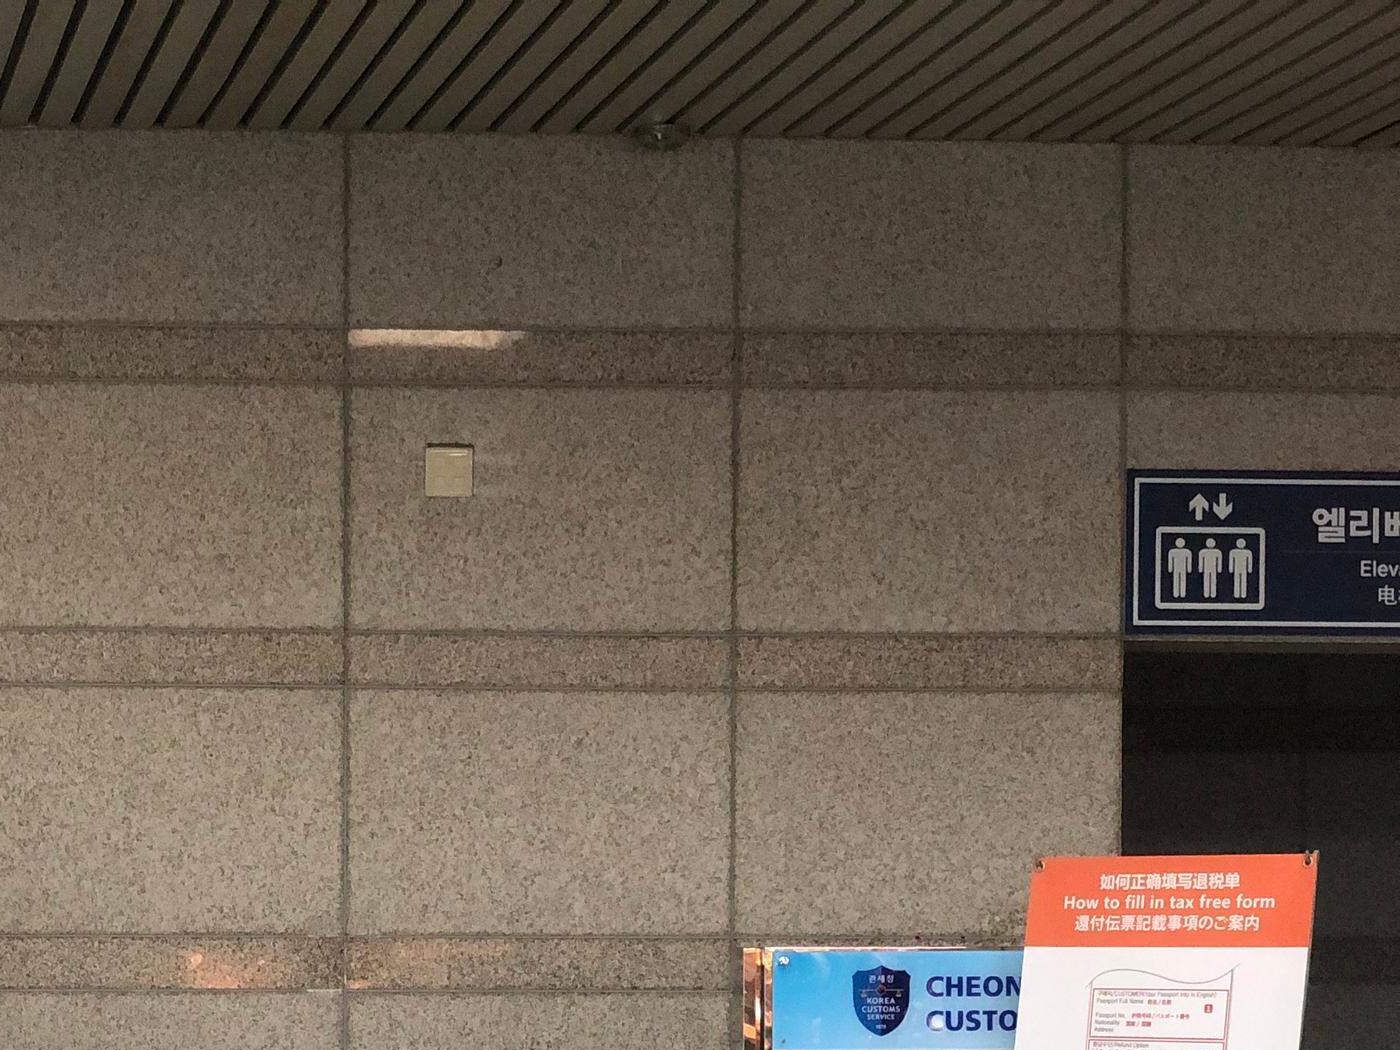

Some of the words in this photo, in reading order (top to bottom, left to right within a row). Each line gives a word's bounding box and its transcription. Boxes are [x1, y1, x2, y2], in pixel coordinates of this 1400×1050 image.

[1360, 560, 1400, 577] Elev
[1378, 585, 1400, 605] 电
[1100, 873, 1240, 890] 如何正确填写退税单
[1064, 896, 1098, 910] How
[1104, 897, 1120, 909] to
[1124, 896, 1144, 908] fill
[1150, 896, 1164, 908] in
[1170, 896, 1194, 908] tax
[1199, 894, 1230, 908] free
[1236, 894, 1275, 908] form
[1074, 915, 1260, 932] 還付伝票記載事項のご案内
[862, 1005, 900, 1013] CUSTOMS
[926, 1010, 1017, 1031] CUSTO
